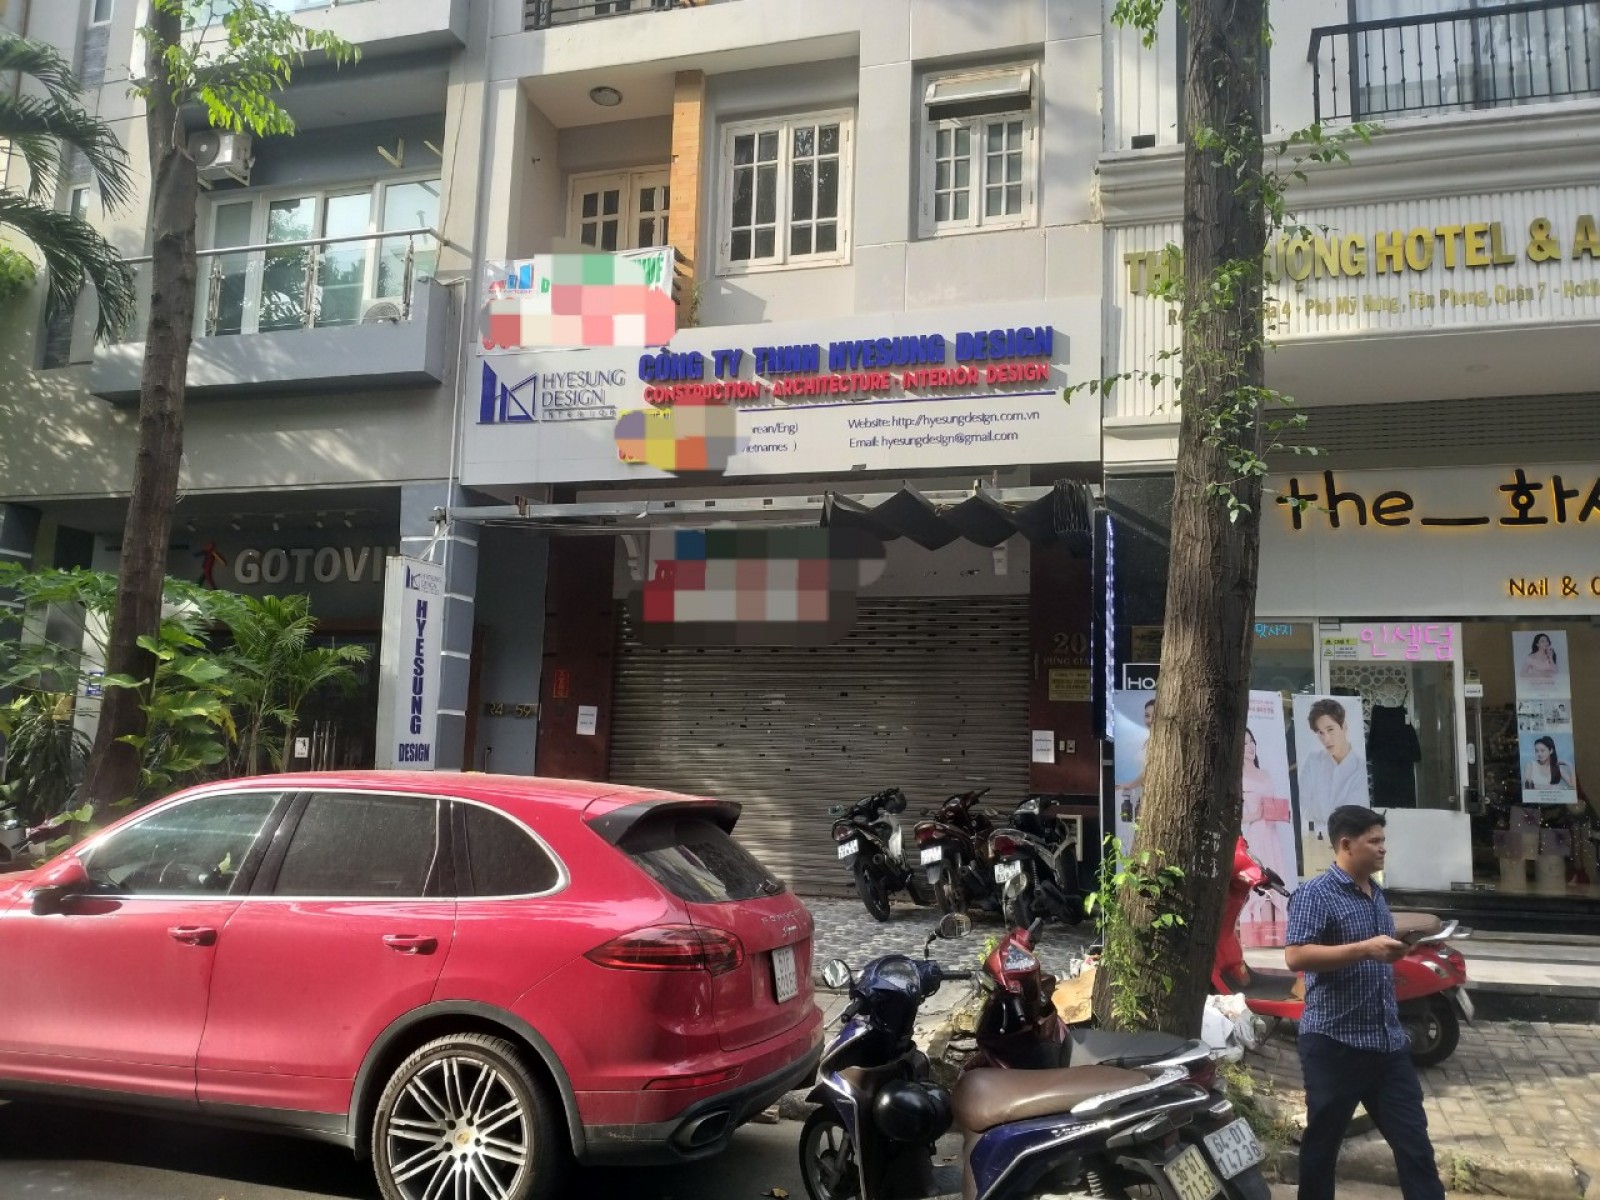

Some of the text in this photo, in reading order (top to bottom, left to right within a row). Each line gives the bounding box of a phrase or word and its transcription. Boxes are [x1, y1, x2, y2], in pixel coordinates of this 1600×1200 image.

[1375, 222, 1516, 274] HOTEL
[1526, 217, 1561, 262] &
[1336, 295, 1357, 316] Mỹ
[1494, 282, 1534, 306] Quận
[1537, 281, 1546, 301] 7
[638, 325, 1053, 381] CÔNG TY TNHH HYESUNG DESIGN
[543, 368, 626, 389] HYESUNG
[772, 371, 891, 397] ARCHITECTURE
[902, 365, 979, 391] INTERIOR
[986, 362, 1050, 386] DESIGN
[542, 389, 606, 408] DESIGN
[848, 416, 891, 430] Website:
[849, 430, 1018, 449] Email: hyesungdesign@gmail.com
[234, 546, 397, 584] GOTOVI
[1509, 577, 1549, 596] Nail
[1562, 576, 1580, 596] &
[1360, 624, 1454, 660] 인셀덤
[409, 599, 428, 735] HYESUNG
[398, 743, 430, 762] DESIGN
